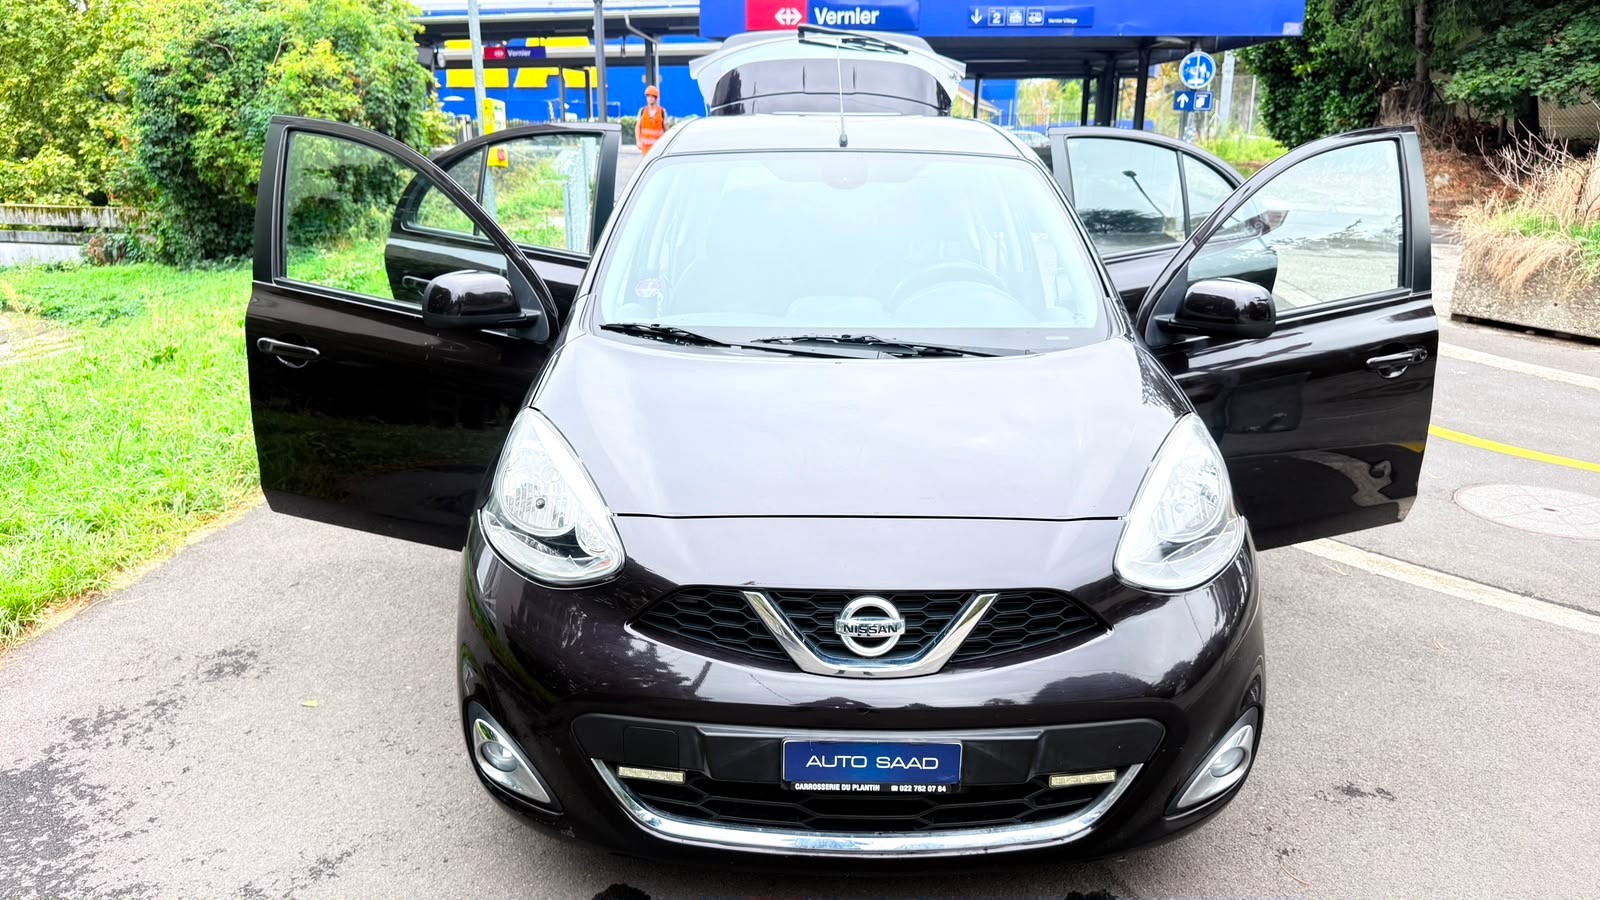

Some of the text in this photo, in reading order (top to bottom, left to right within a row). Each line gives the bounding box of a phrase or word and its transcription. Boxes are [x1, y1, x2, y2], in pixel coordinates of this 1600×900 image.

[814, 6, 880, 25] Vernier
[992, 12, 1001, 24] 2
[507, 49, 531, 57] Vernier
[843, 624, 898, 634] NISSAN
[806, 755, 939, 770] AUTO SAAD
[795, 783, 840, 791] CARROSSERIE
[841, 783, 851, 791] DU
[852, 784, 880, 792] PLANTIN
